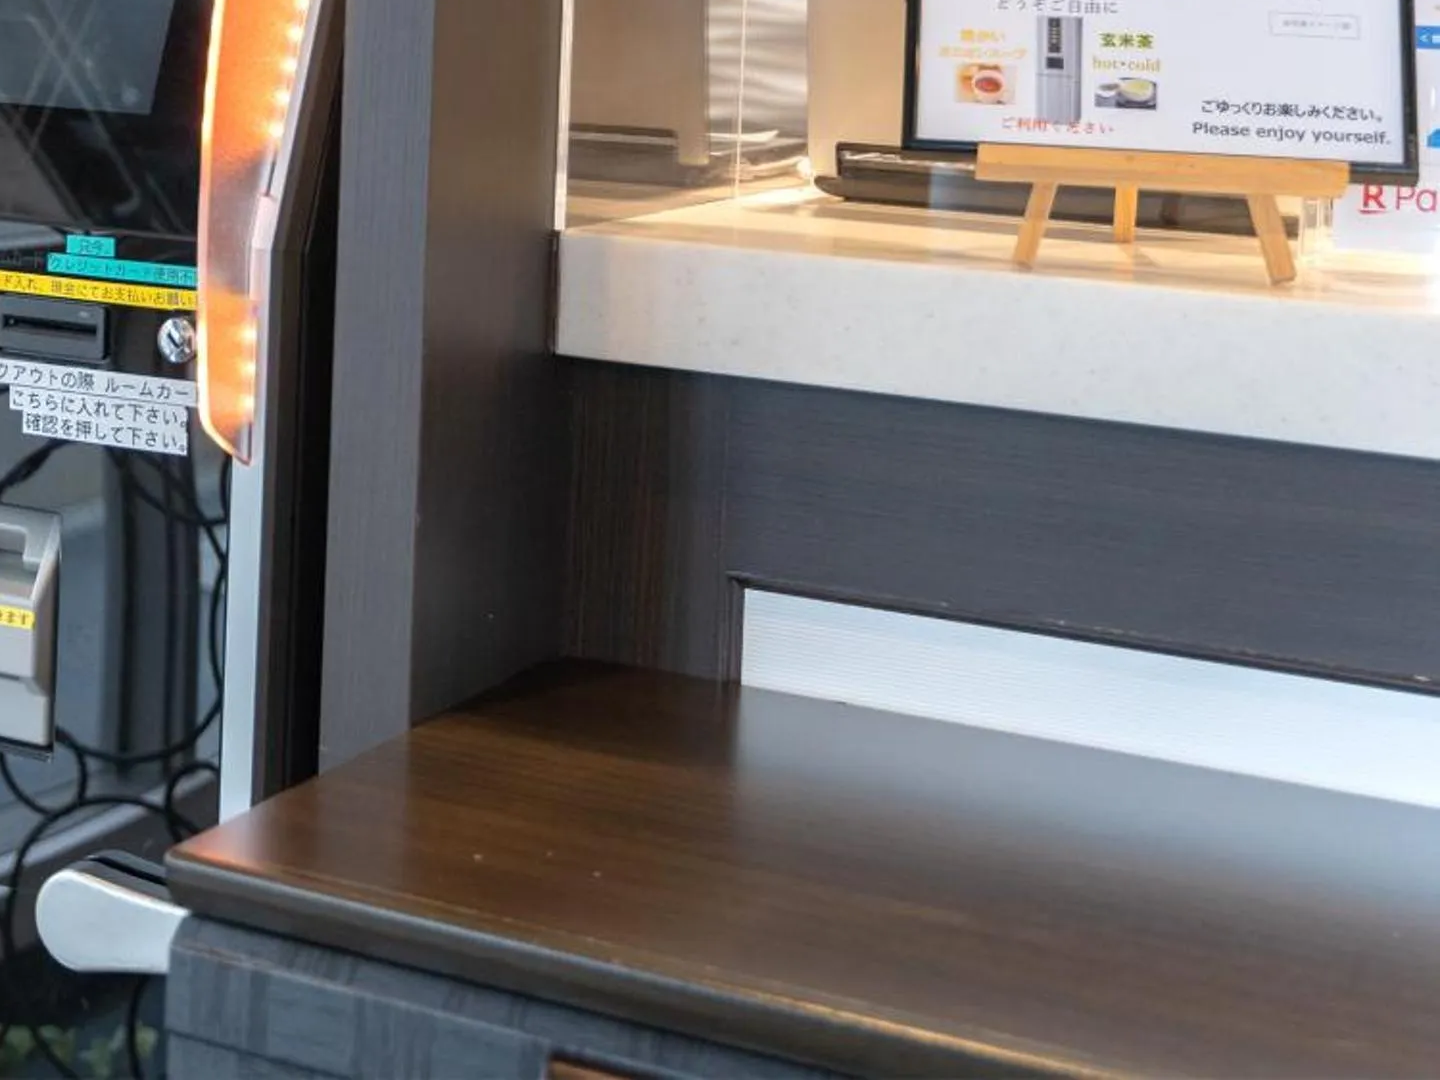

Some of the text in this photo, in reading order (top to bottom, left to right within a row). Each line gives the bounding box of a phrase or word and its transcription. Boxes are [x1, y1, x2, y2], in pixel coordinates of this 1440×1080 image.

[1099, 31, 1155, 50] 玄米茶
[1200, 99, 1383, 123] ごゆっくりお楽しみください。
[1191, 120, 1392, 146] Please enjoy yourself.
[1361, 179, 1387, 209] R
[103, 376, 191, 401] ルームカー
[12, 390, 187, 429] こちらに入れて下さい。
[24, 412, 187, 453] 確認を押して下さい。
